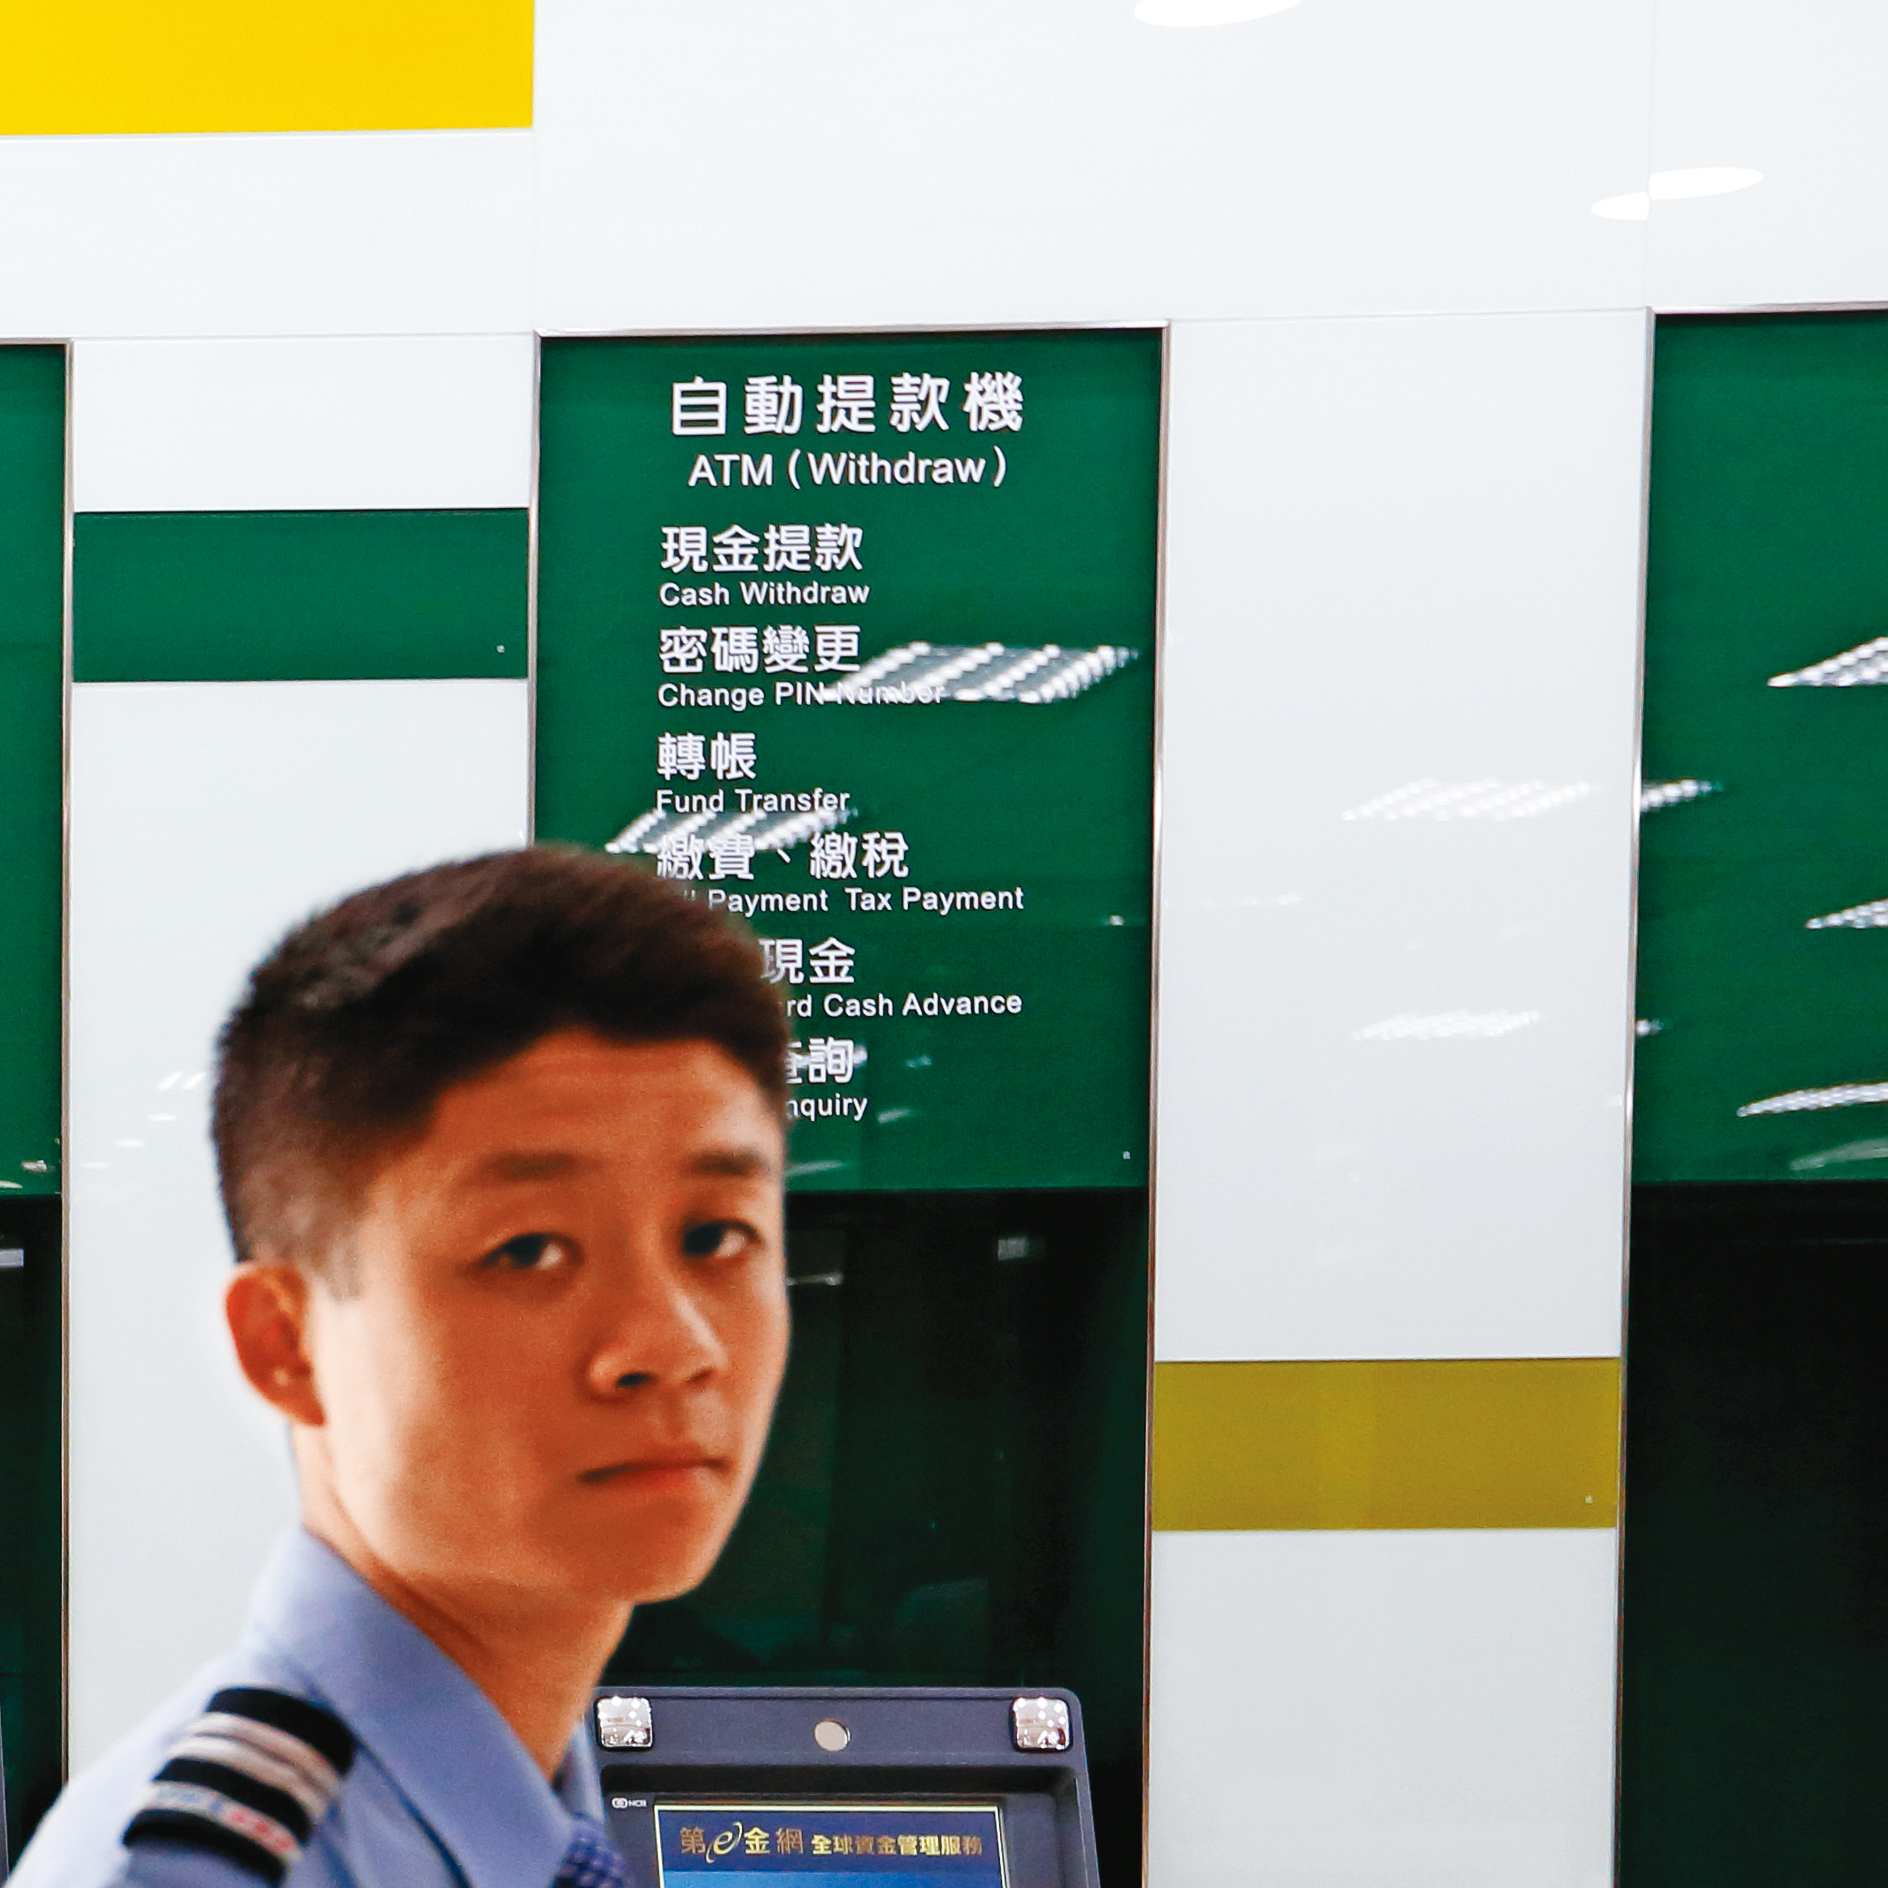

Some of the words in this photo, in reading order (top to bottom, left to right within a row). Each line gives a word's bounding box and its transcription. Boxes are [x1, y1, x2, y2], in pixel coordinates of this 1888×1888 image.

[672, 371, 1024, 436] 自動提款機
[688, 453, 773, 487] ATM
[660, 522, 863, 573] 現金提款
[659, 582, 730, 606] Cash
[740, 580, 870, 605] Withdraw
[658, 625, 861, 675] 密碼變更
[658, 683, 765, 712] Change
[775, 682, 825, 706] PIN
[836, 682, 945, 706] Number
[657, 731, 757, 781] 轉帳
[656, 790, 724, 812] Fund
[734, 787, 850, 812] Transfer
[708, 889, 829, 918] Payment
[844, 887, 892, 911] Tax
[903, 887, 1024, 916] Payment
[759, 937, 856, 985] 現金
[787, 994, 812, 1017] rd
[824, 993, 893, 1017] Cash
[902, 992, 1022, 1016] Advance
[787, 1095, 868, 1122] nquiry
